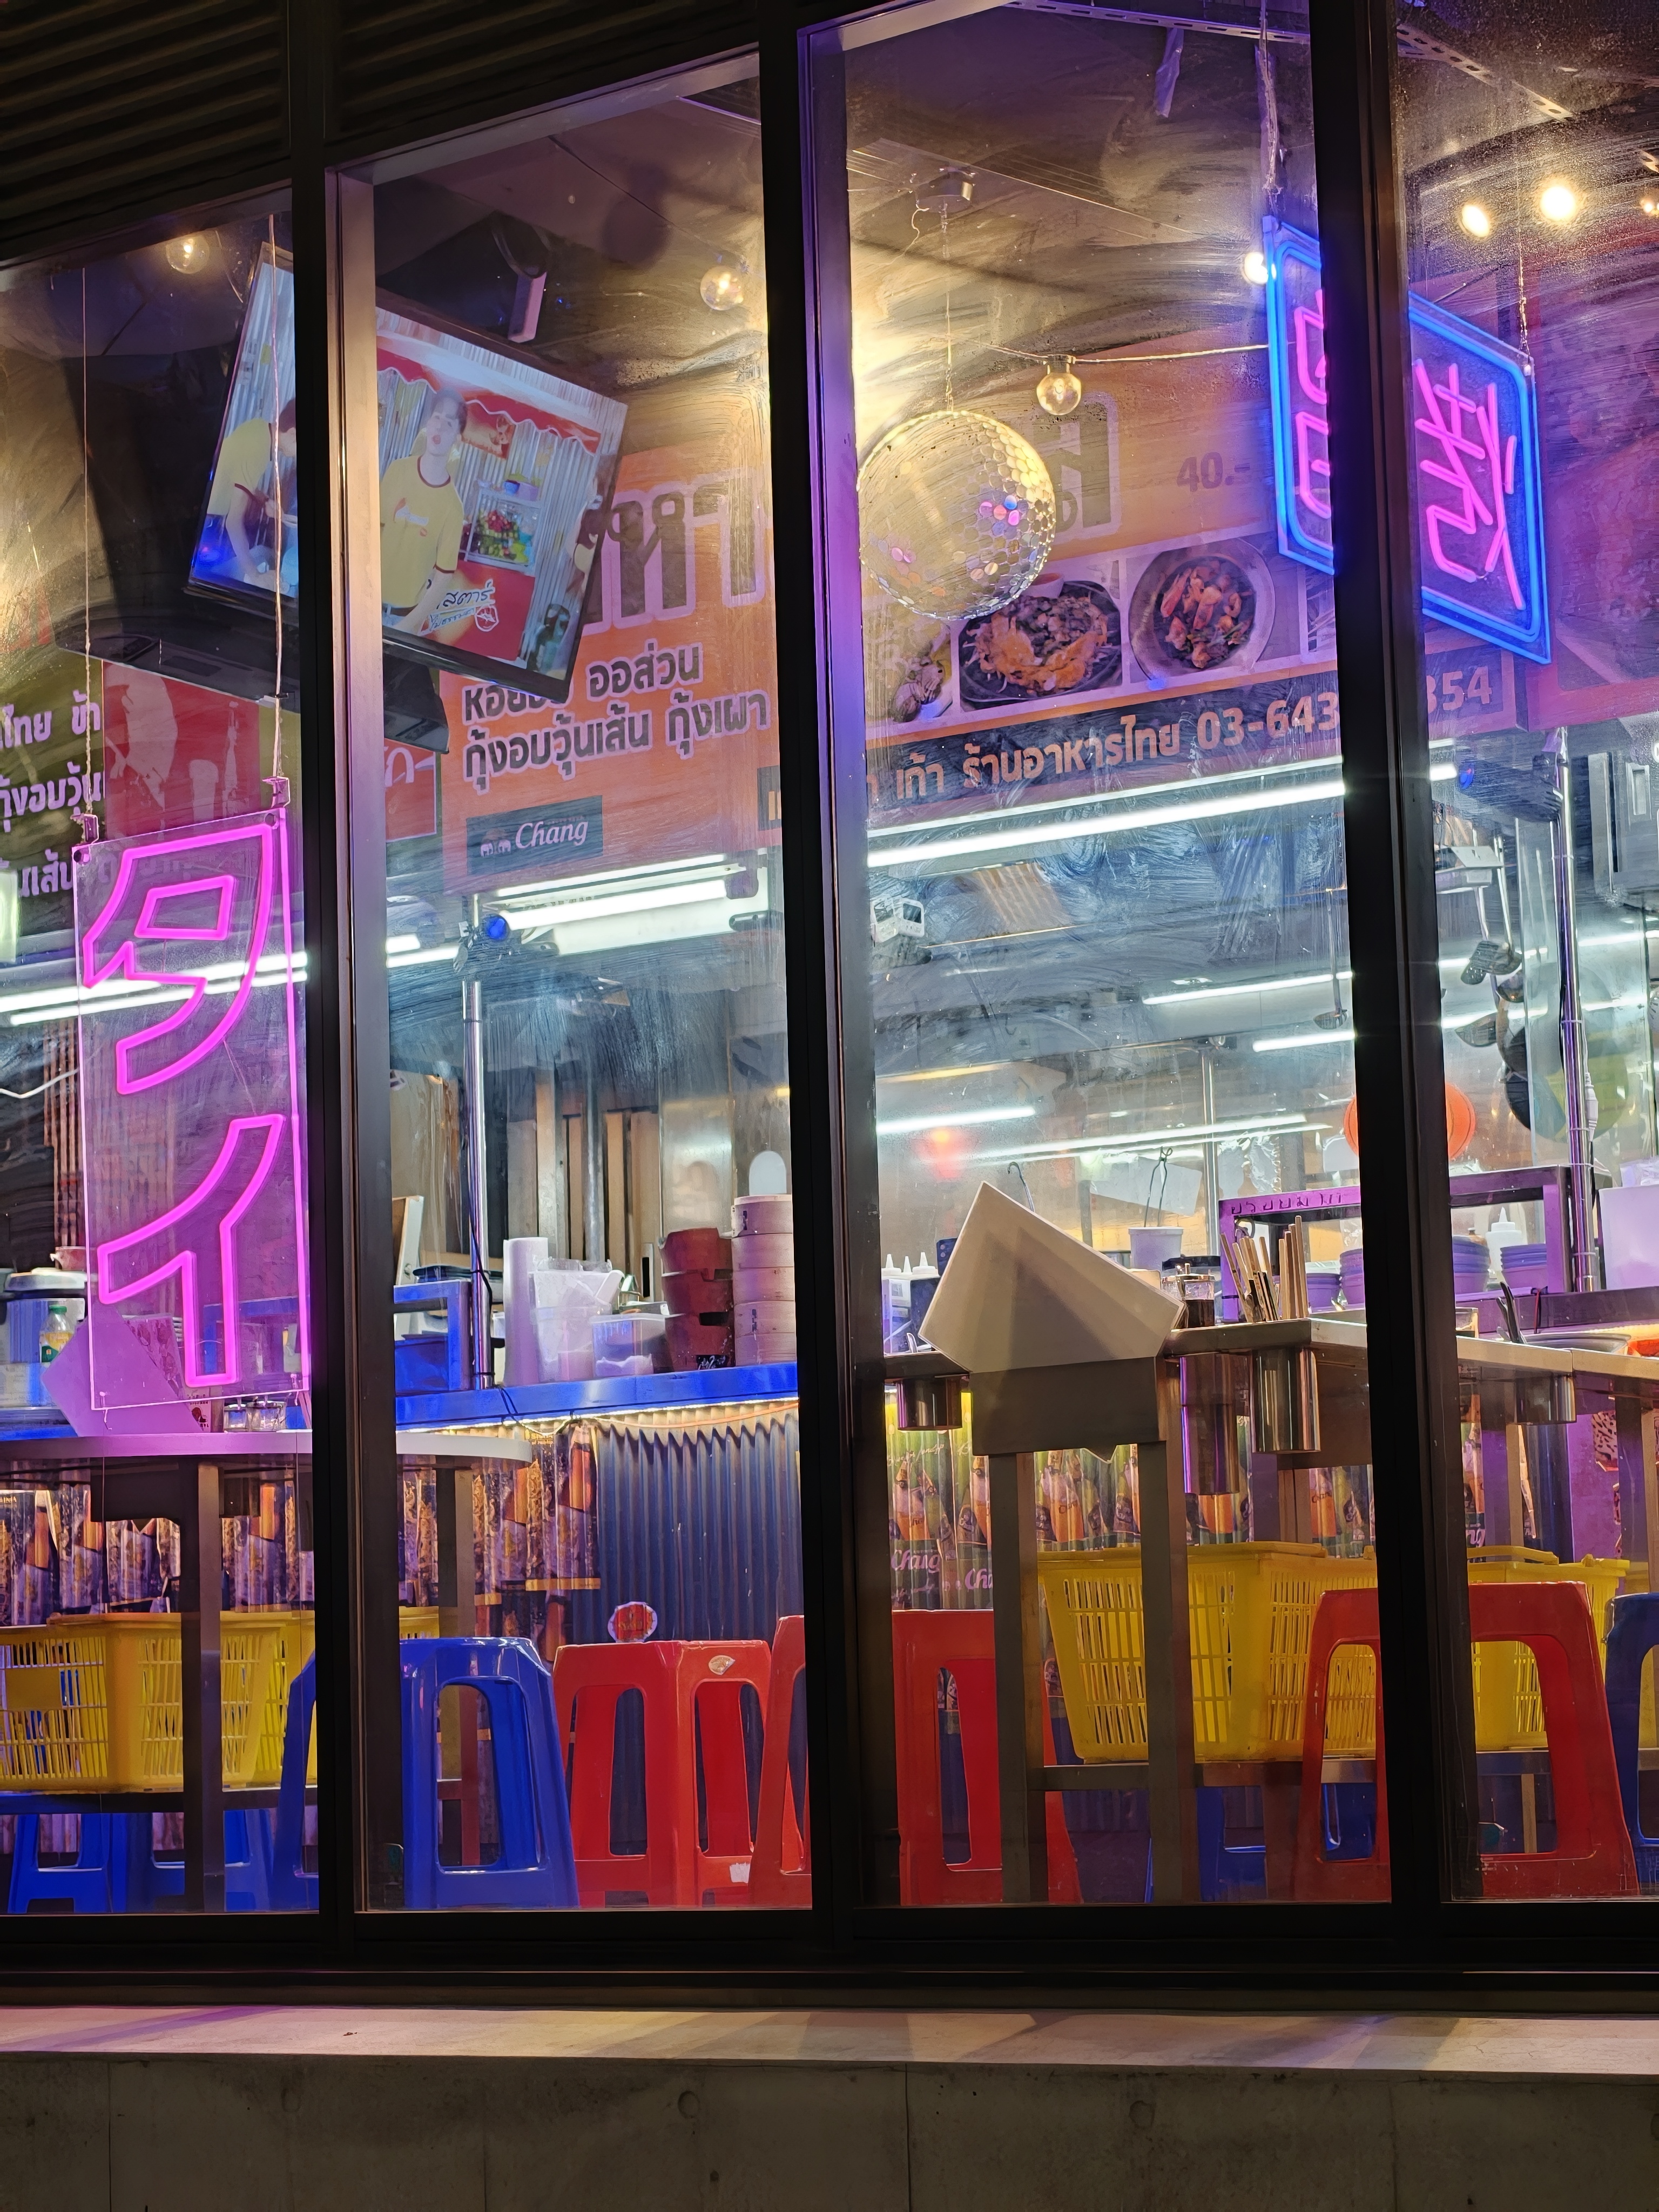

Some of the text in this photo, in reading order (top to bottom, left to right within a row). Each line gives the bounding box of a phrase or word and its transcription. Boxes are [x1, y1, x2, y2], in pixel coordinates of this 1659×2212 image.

[1176, 451, 1251, 492] 40.-
[589, 642, 700, 698] ออส่วน
[0, 703, 52, 748] ไทย
[465, 703, 650, 791] กุ้งอบวุ้นเส้น
[668, 691, 767, 756] กุ้งเผา
[962, 714, 1181, 789] ร้านอาหารไทย
[896, 751, 944, 800] เก้า
[515, 820, 589, 849] Chang
[83, 824, 286, 1388] タイ
